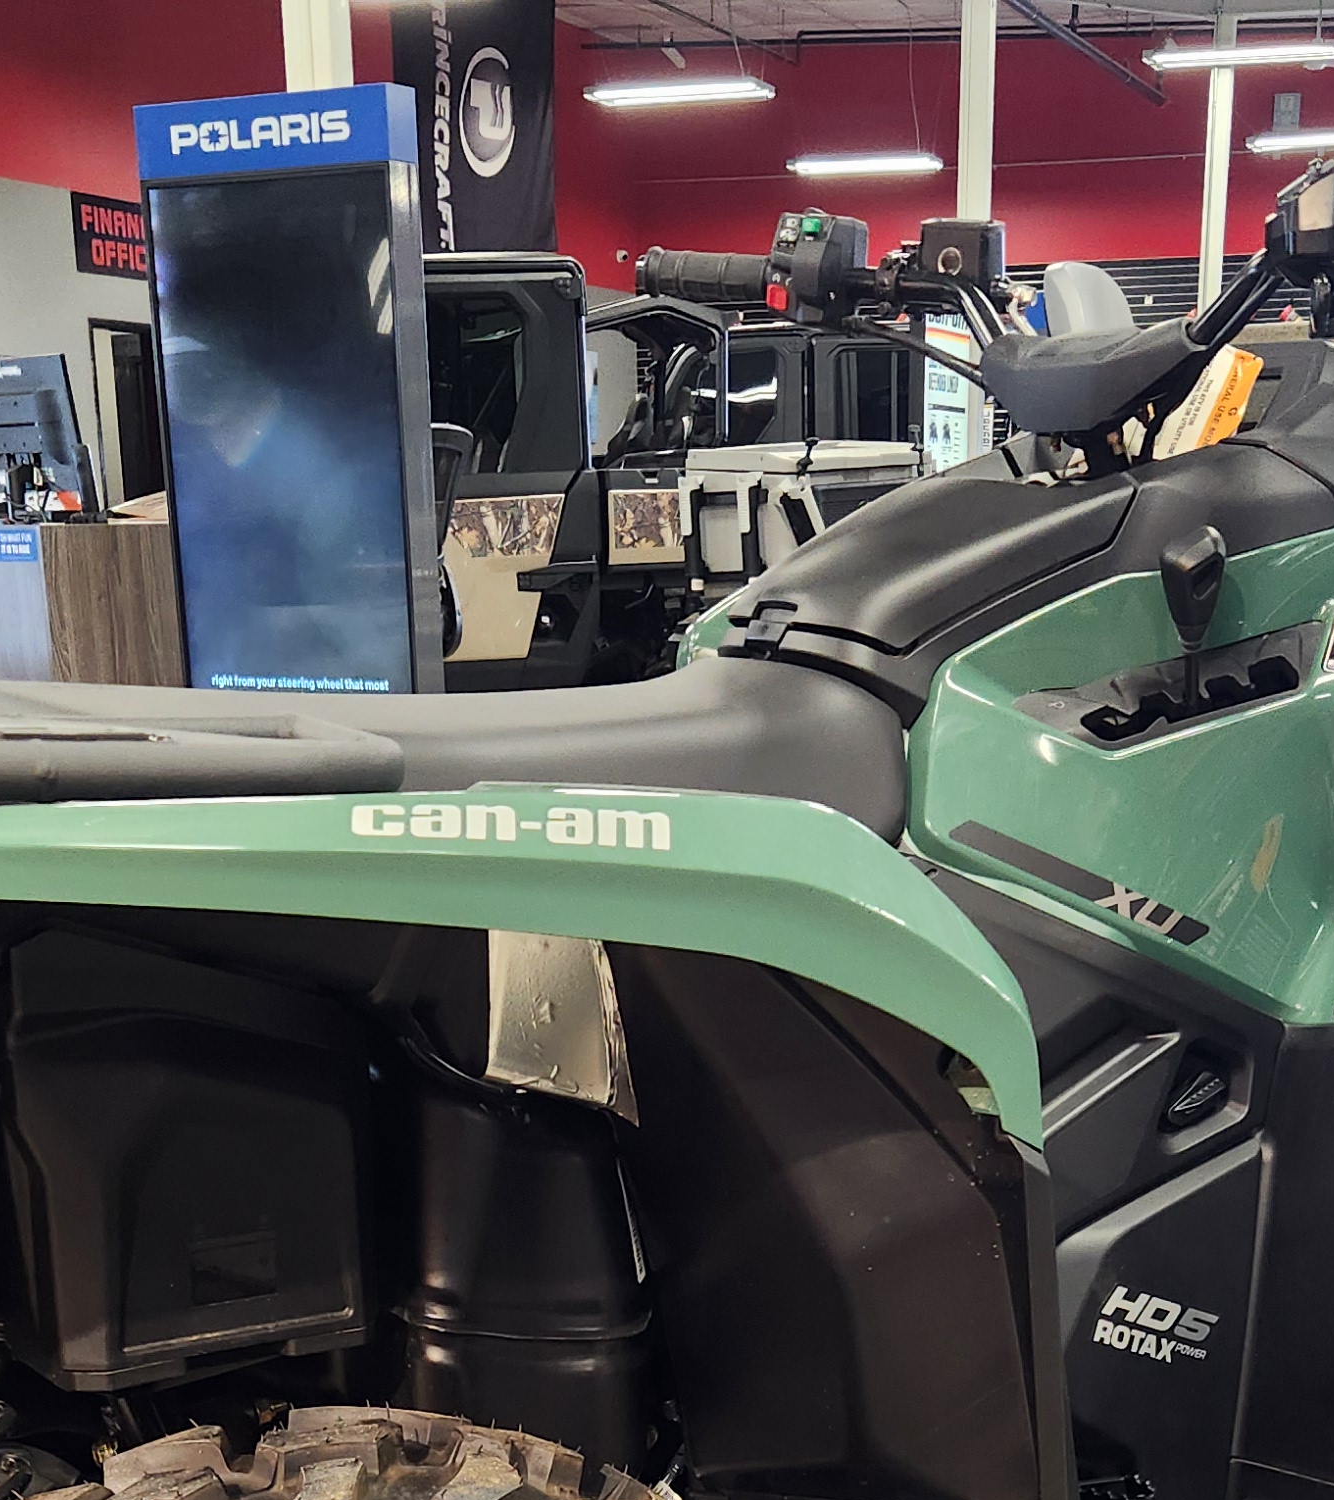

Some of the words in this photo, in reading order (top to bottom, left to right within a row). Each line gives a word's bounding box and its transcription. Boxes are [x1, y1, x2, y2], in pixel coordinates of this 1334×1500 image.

[170, 109, 351, 155] POLARIS
[431, 0, 455, 251] RINCECRAFT.
[80, 203, 146, 240] FINAN
[211, 674, 233, 689] right
[234, 674, 255, 687] from
[256, 677, 276, 690] your
[278, 676, 315, 691] steering
[316, 676, 343, 690] wheel
[343, 678, 364, 690] that
[364, 679, 389, 691] most
[351, 804, 670, 850] can-am
[1101, 1285, 1220, 1342] HD5
[1093, 1318, 1177, 1364] ROTAX
[1174, 1342, 1207, 1360] POWER
